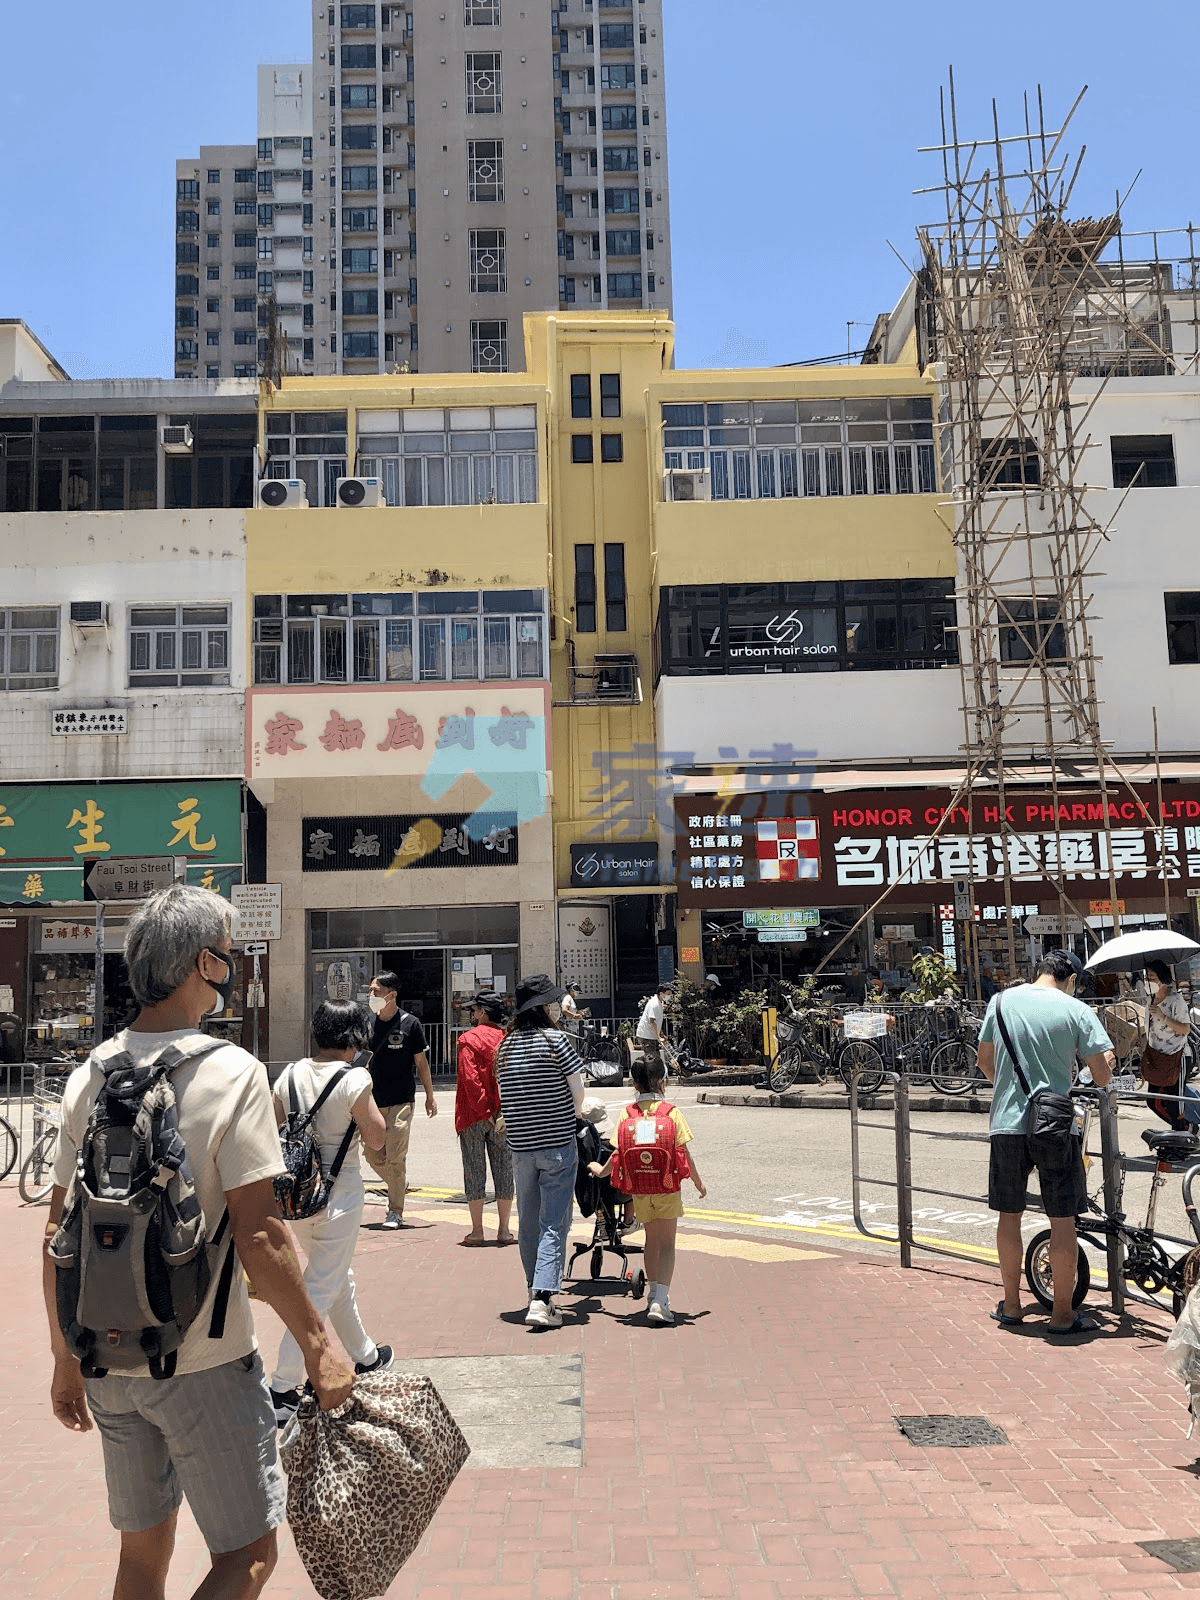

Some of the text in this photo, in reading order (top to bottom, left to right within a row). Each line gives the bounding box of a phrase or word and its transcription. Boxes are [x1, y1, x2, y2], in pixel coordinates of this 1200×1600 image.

[729, 644, 837, 656] urban hair salon
[688, 814, 742, 828] 政府註冊
[832, 808, 913, 827] HONOR
[924, 806, 969, 825] CITY
[984, 805, 1015, 823] HK
[1026, 801, 1150, 822] PHARMACY
[689, 835, 744, 848] 社區藥房
[600, 858, 655, 869] Urban Hair
[690, 855, 744, 869] 精配處方
[833, 829, 1148, 886] 名城香港藥房
[96, 862, 171, 875] Fau Tsoi Street
[21, 873, 45, 898] 藥
[690, 875, 745, 889] 信心保證
[773, 1192, 899, 1214] LOOK
